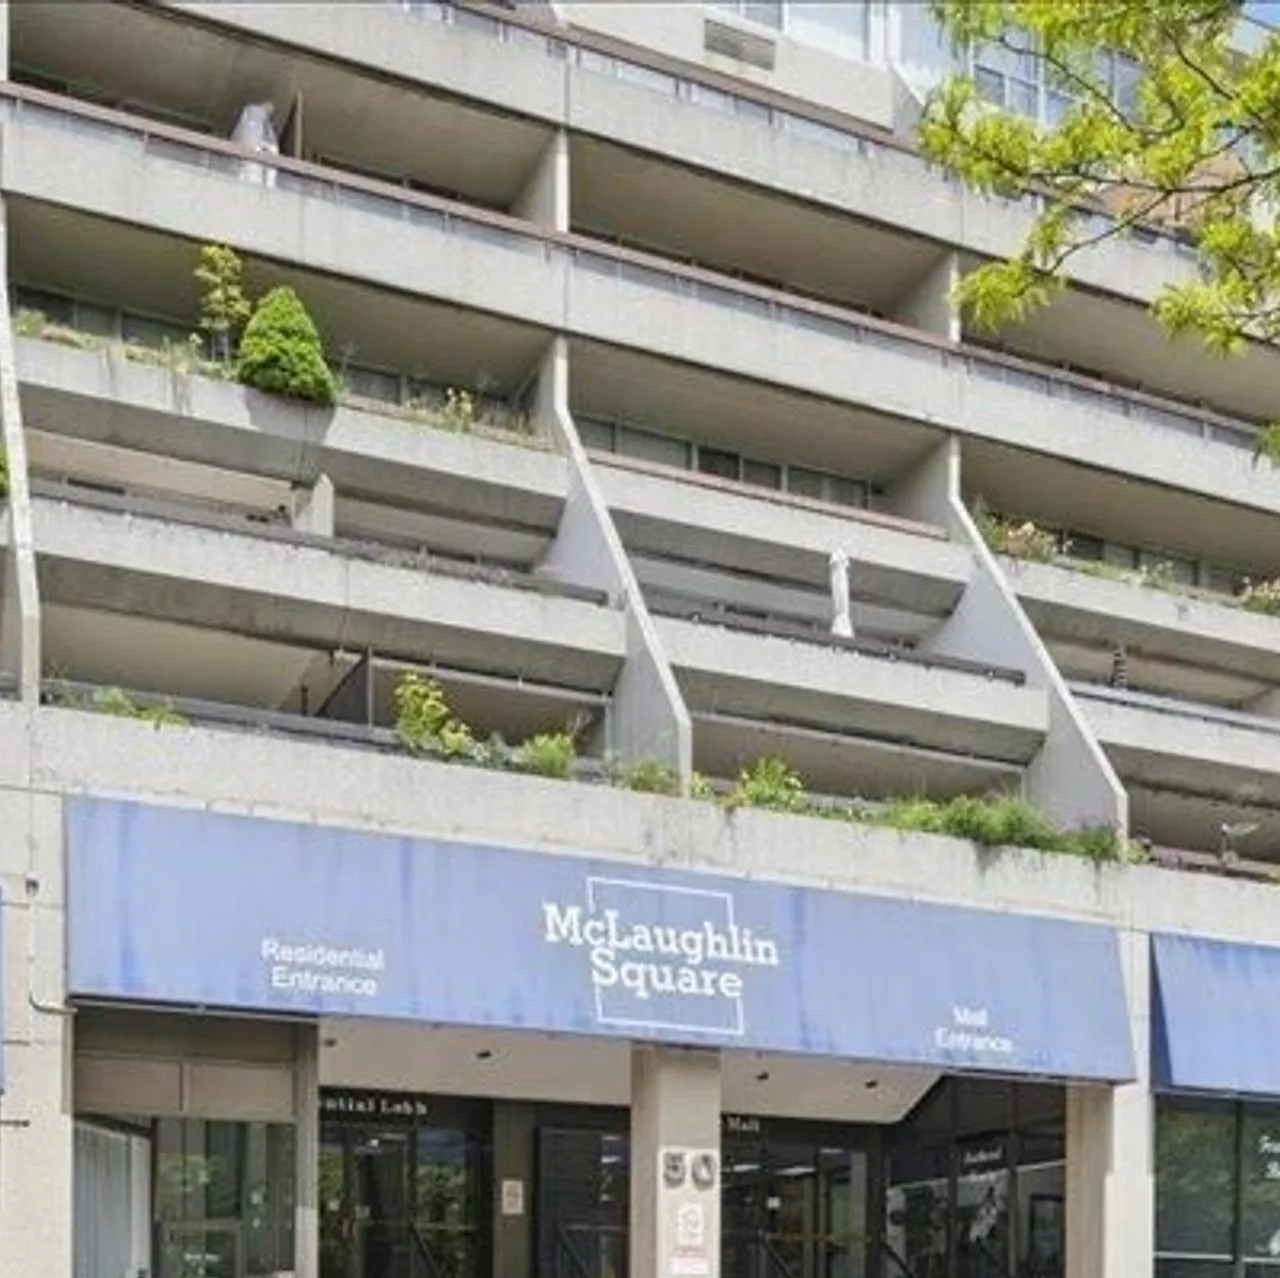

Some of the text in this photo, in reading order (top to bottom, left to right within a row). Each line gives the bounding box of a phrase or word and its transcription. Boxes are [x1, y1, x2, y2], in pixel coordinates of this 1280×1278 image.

[542, 901, 780, 965] McLaughlin
[260, 937, 385, 971] Residential
[590, 948, 744, 999] Square
[271, 965, 377, 996] Entrance
[662, 1151, 716, 1191] 50
